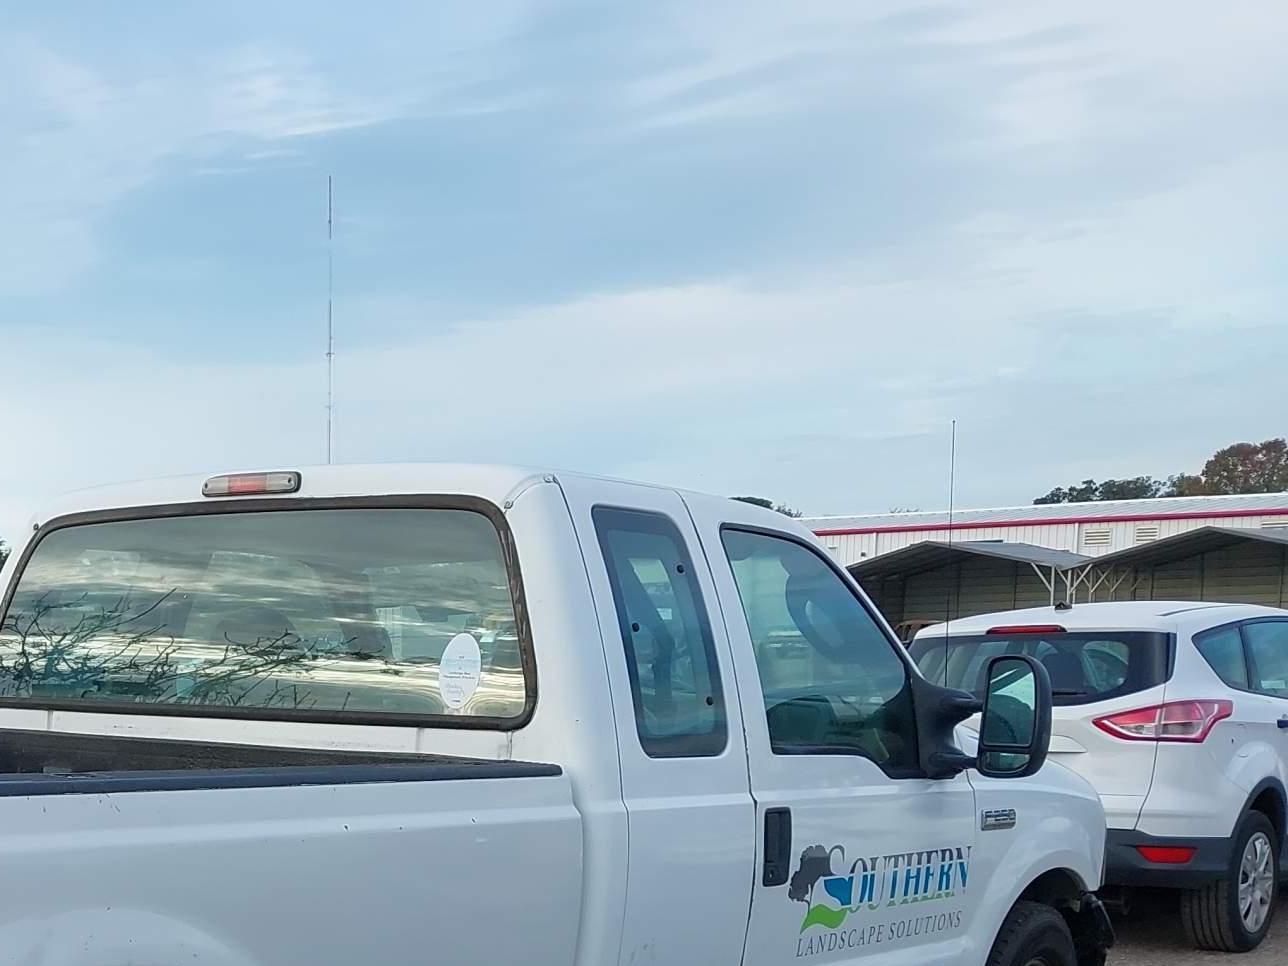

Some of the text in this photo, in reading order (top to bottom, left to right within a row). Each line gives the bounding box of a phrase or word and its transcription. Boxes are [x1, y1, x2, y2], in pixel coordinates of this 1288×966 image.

[828, 844, 972, 914] SOUTHERN
[795, 910, 963, 958] LANDSCAPE SOLUTIONS
